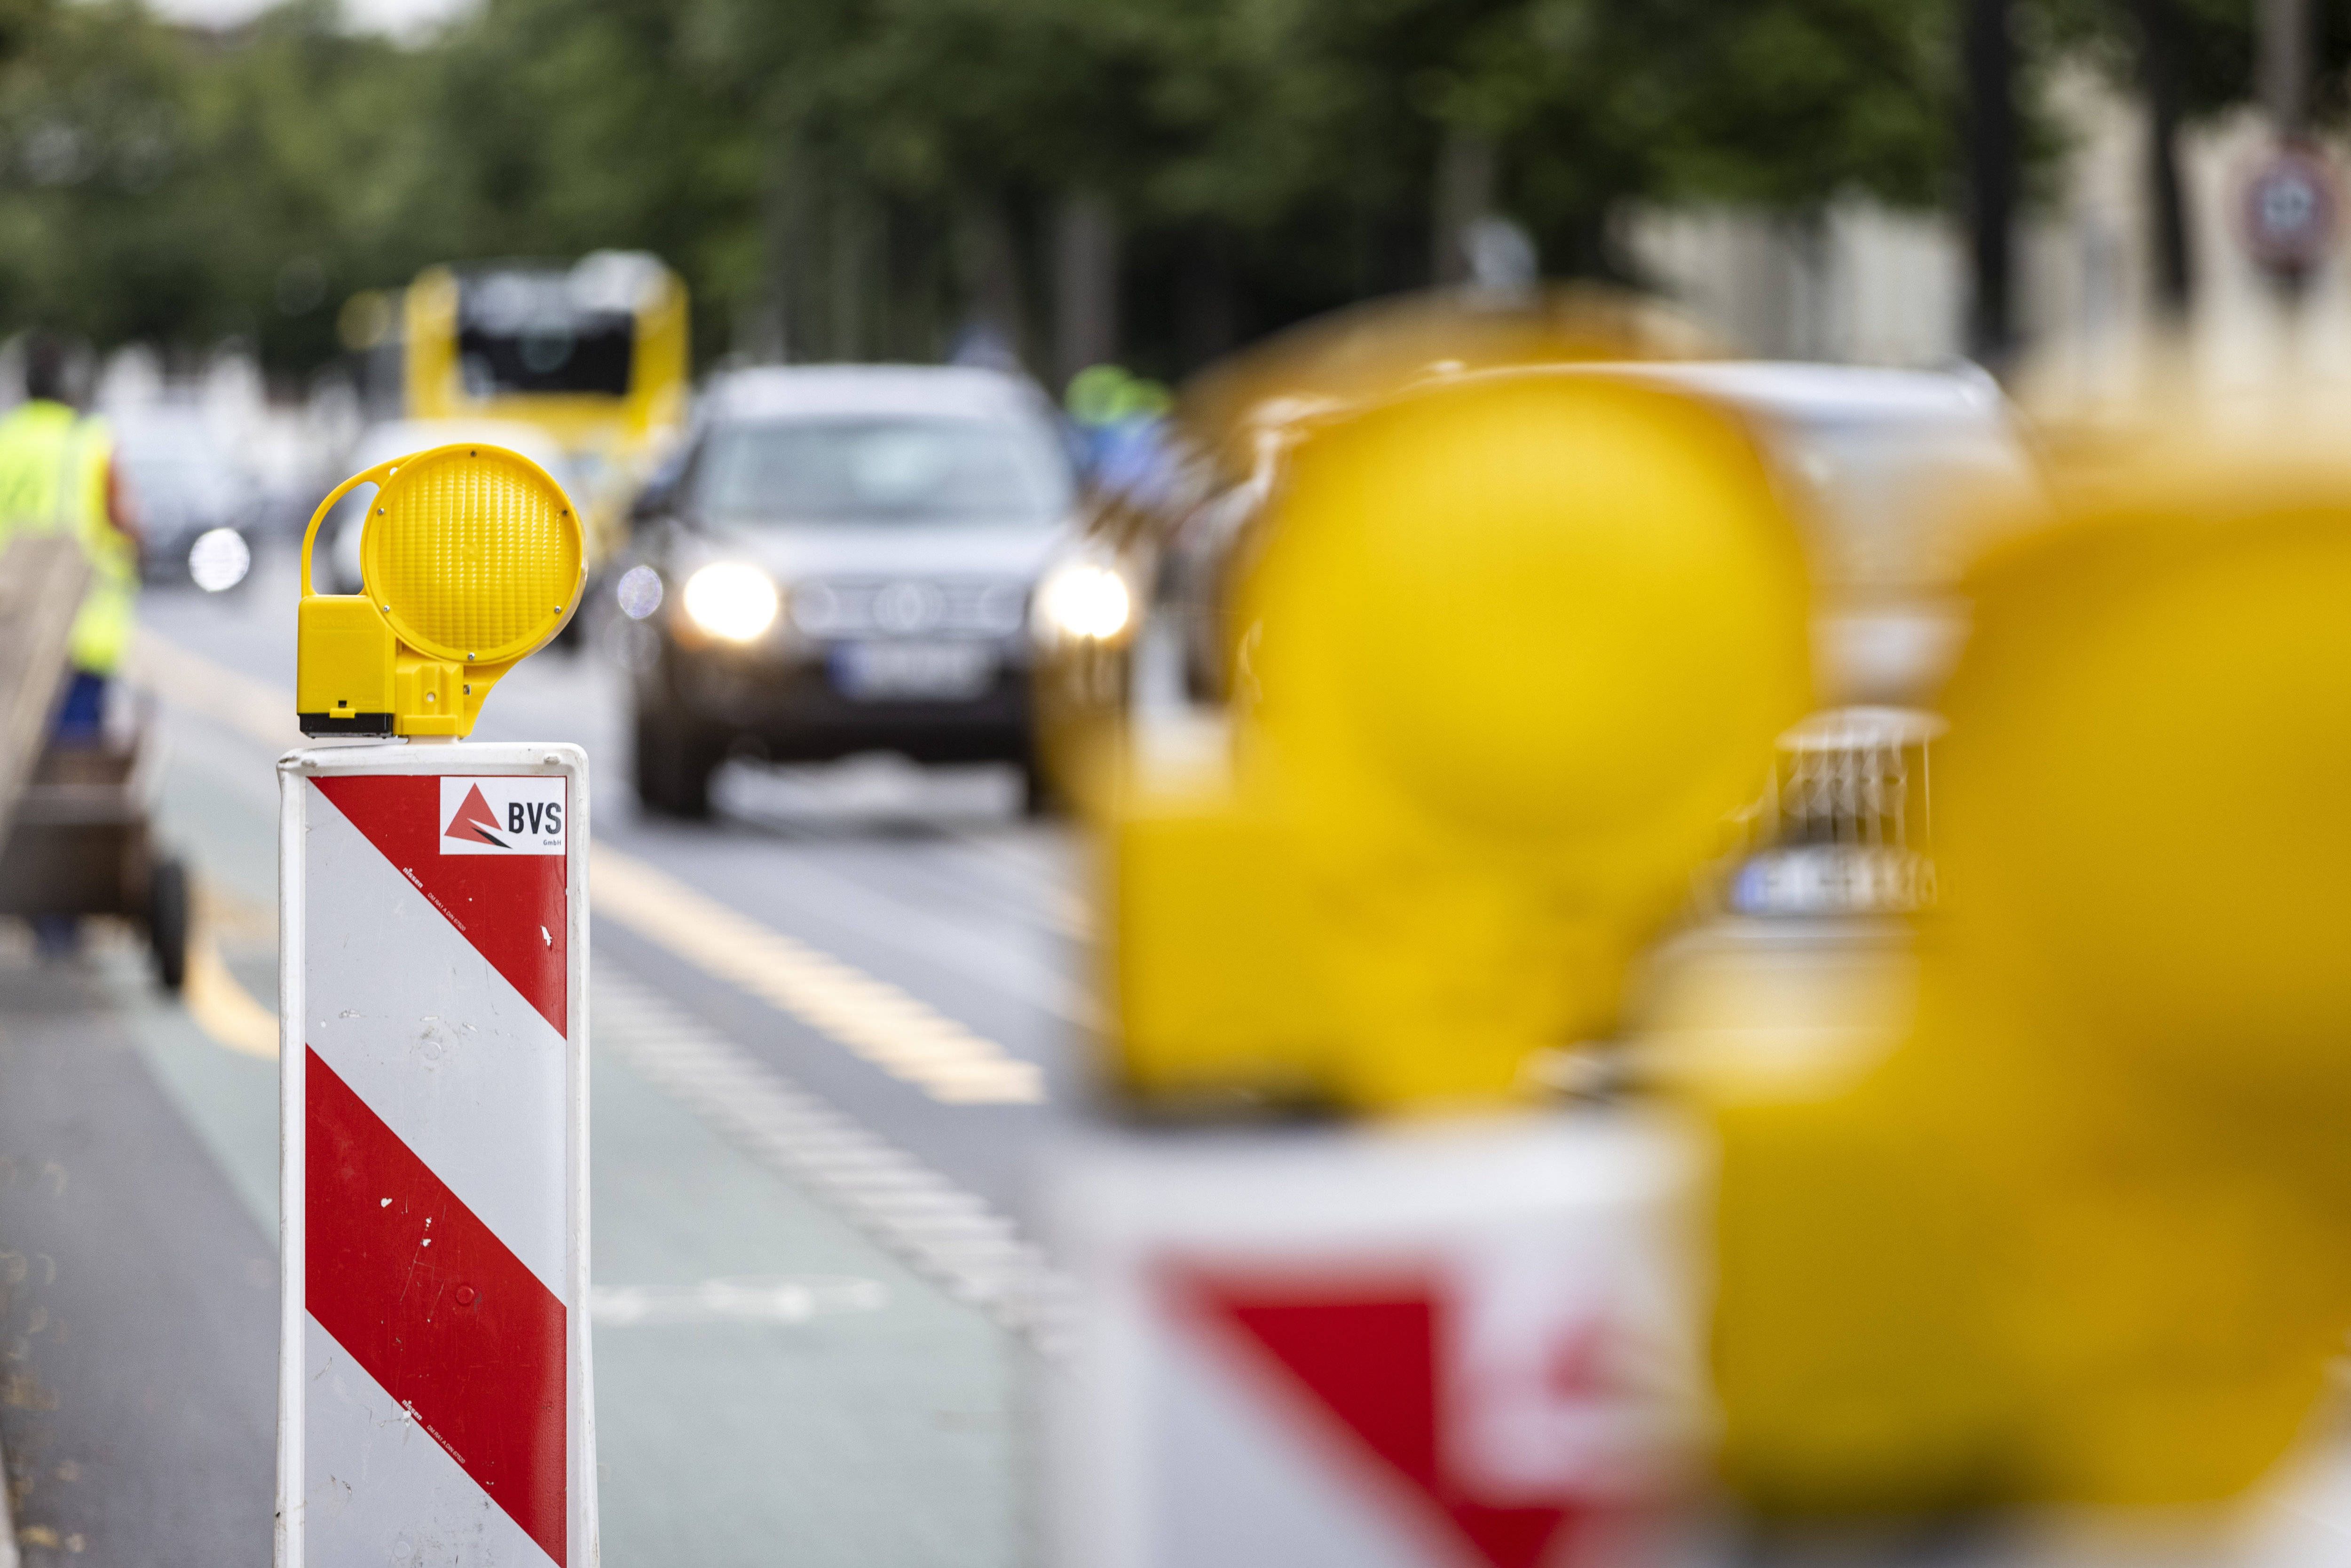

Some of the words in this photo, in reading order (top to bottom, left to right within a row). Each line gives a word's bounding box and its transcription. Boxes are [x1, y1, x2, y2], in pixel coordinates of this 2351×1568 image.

[508, 802, 561, 835] BVS
[403, 867, 423, 888] nissen
[402, 1400, 423, 1421] nissen
